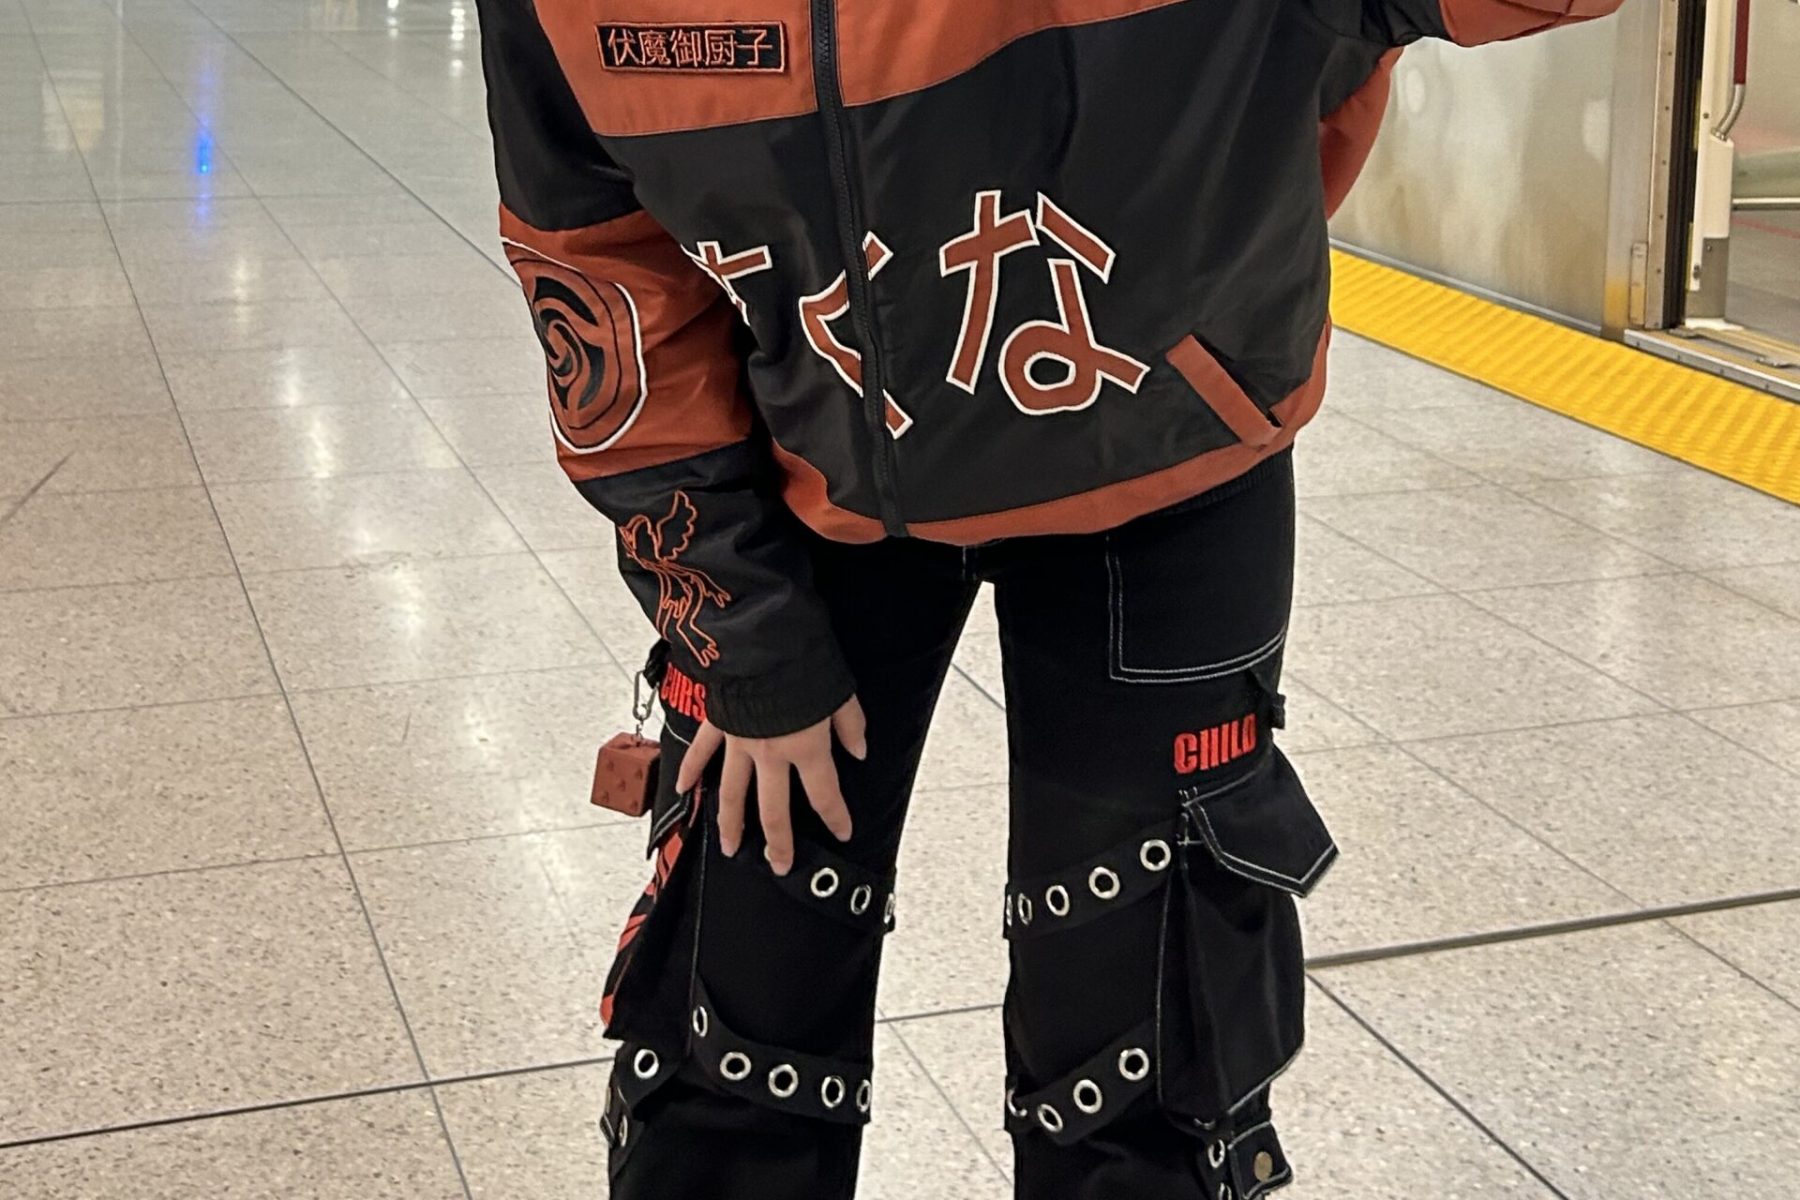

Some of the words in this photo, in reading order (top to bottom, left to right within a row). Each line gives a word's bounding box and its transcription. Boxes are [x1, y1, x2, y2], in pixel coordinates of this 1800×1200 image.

[607, 28, 773, 68] 伏魔御厨子
[1173, 712, 1256, 774] CHILD
